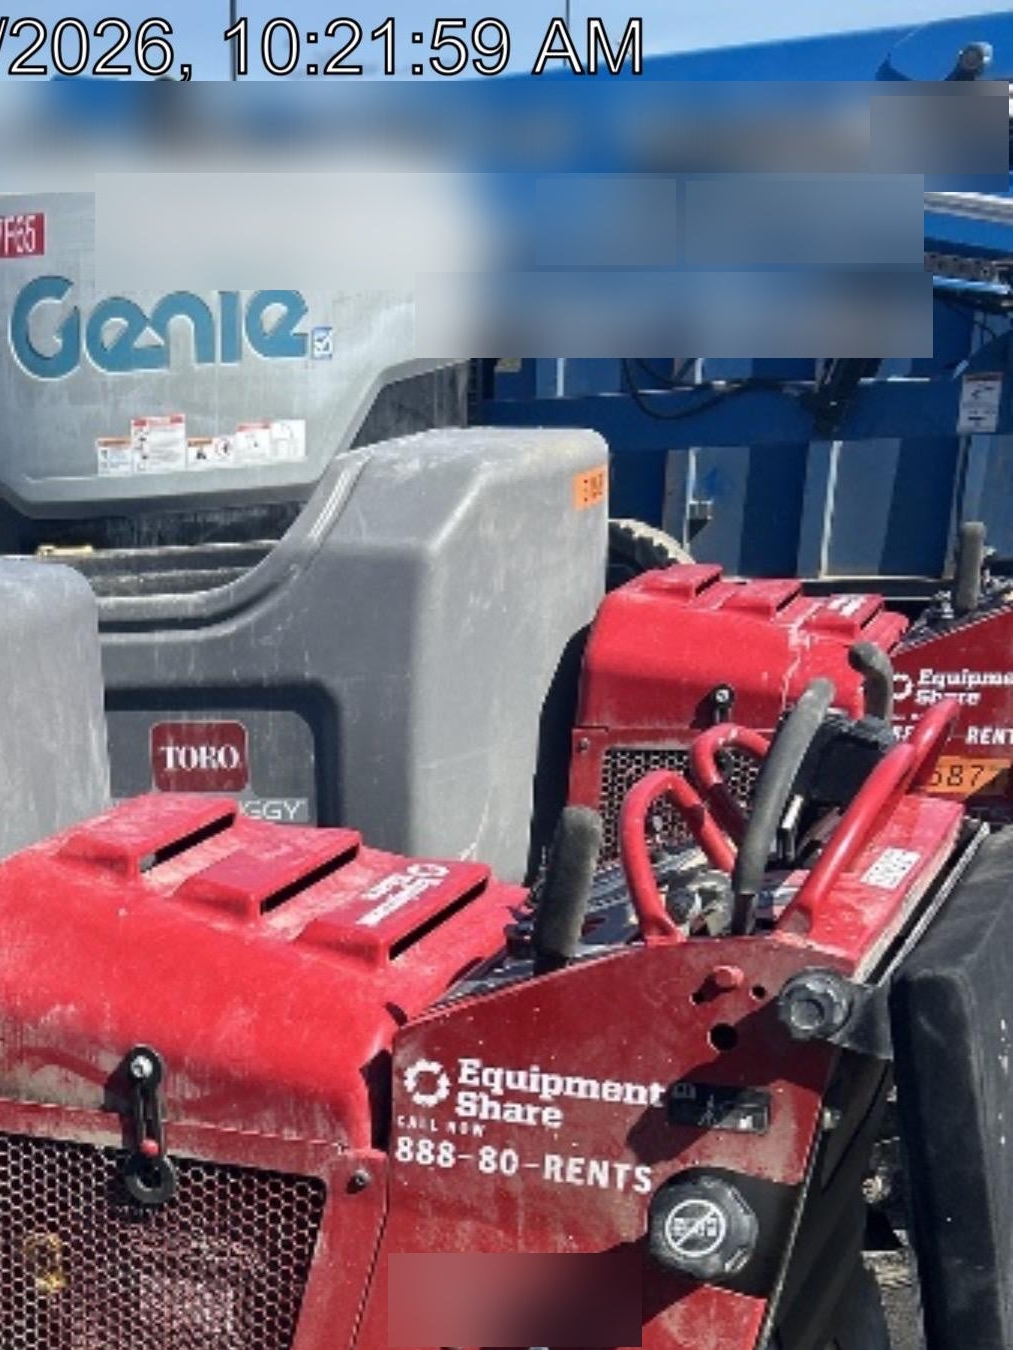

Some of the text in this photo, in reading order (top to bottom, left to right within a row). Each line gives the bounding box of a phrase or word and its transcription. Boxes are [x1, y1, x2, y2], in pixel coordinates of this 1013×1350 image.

[161, 744, 240, 771] TORO
[458, 1058, 666, 1107] Equipment
[455, 1091, 564, 1128] Share
[395, 1135, 653, 1193] 888-80-RENTS
